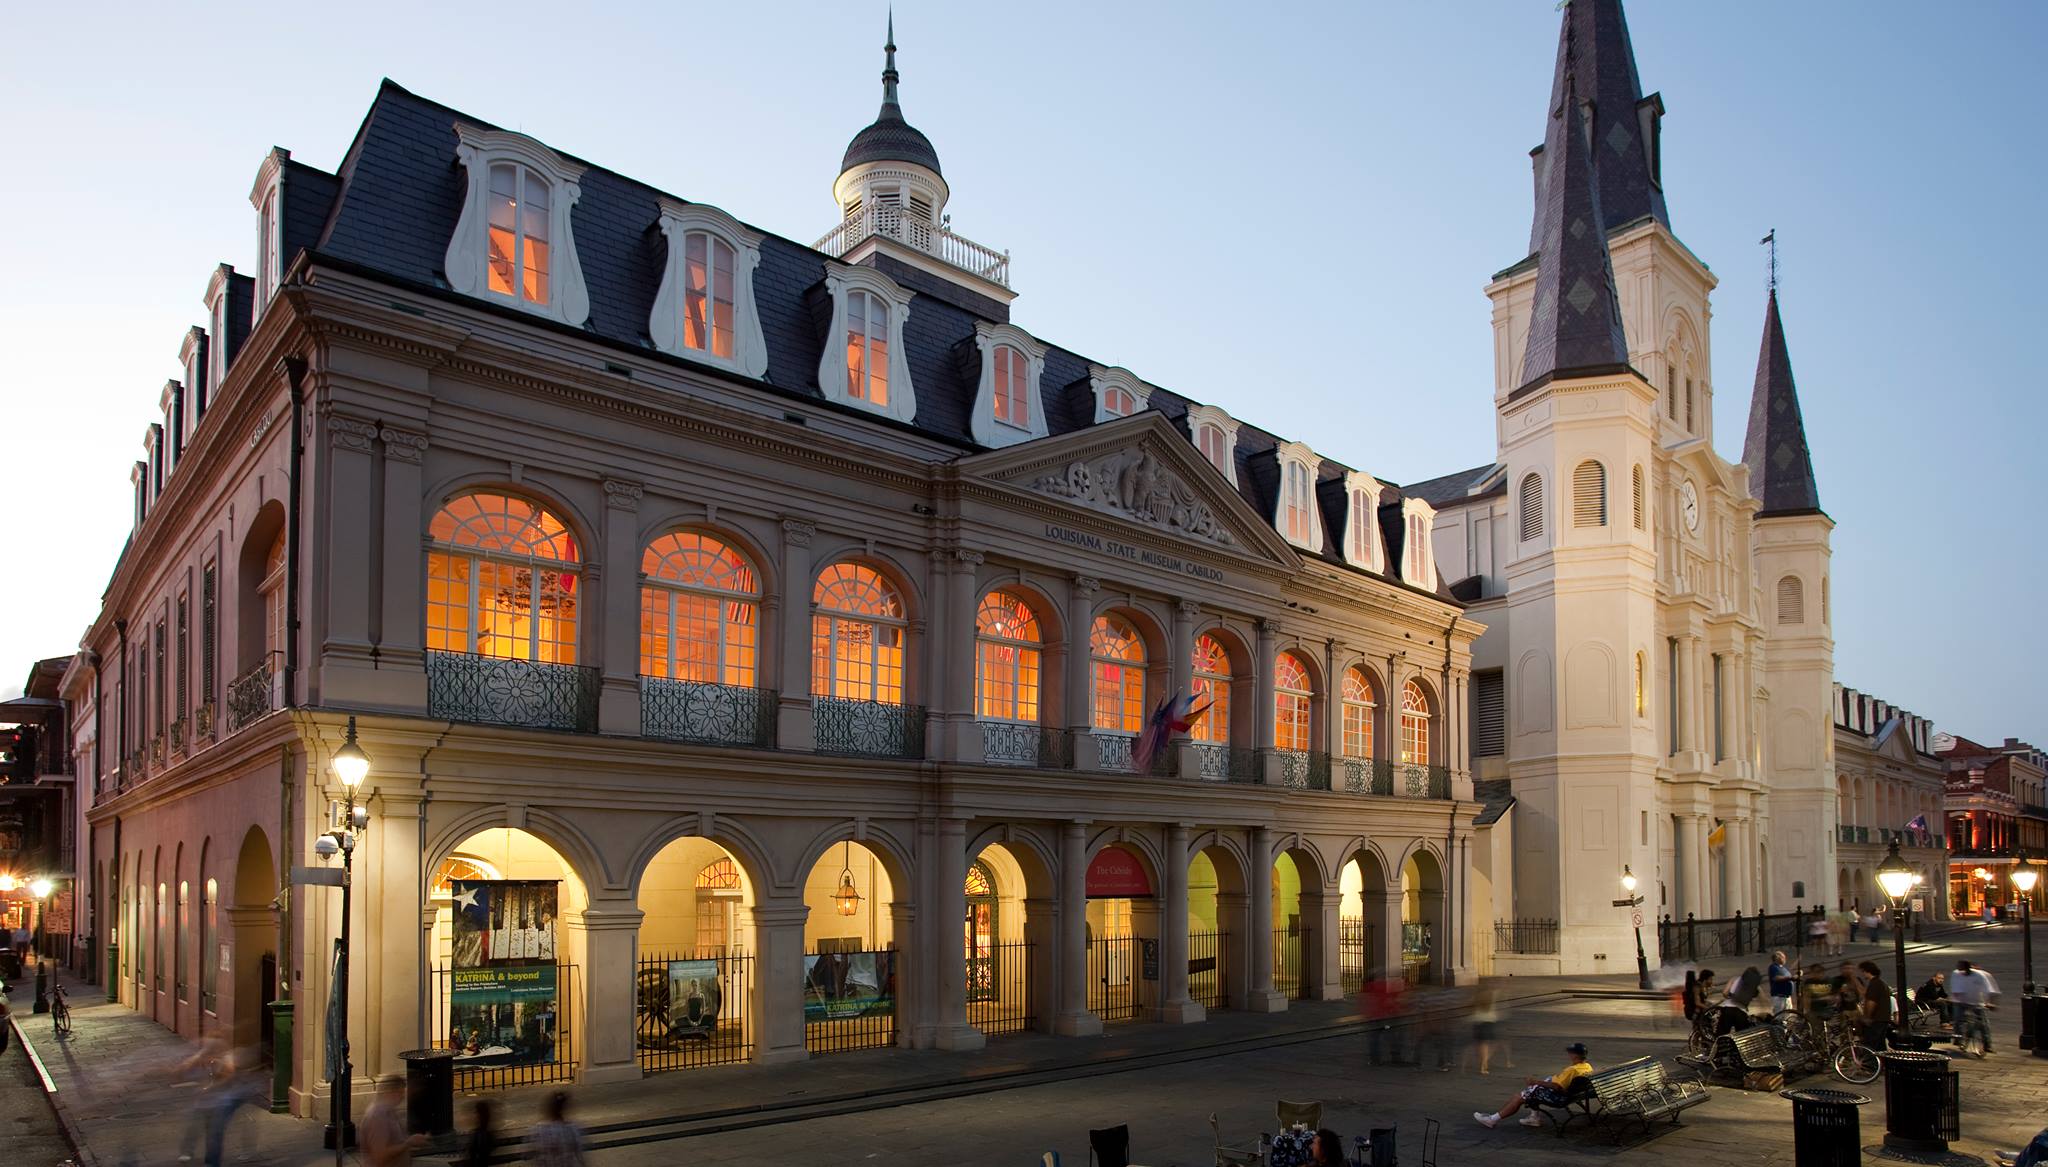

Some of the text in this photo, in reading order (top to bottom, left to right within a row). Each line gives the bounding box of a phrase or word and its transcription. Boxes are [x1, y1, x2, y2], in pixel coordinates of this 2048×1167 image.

[1045, 524, 1223, 582] LOUISIANA STATE MUSEUM CABILDO
[1096, 865, 1109, 875] The
[455, 971, 540, 983] KATRINA & beyond
[827, 1003, 858, 1012] KATRINA
